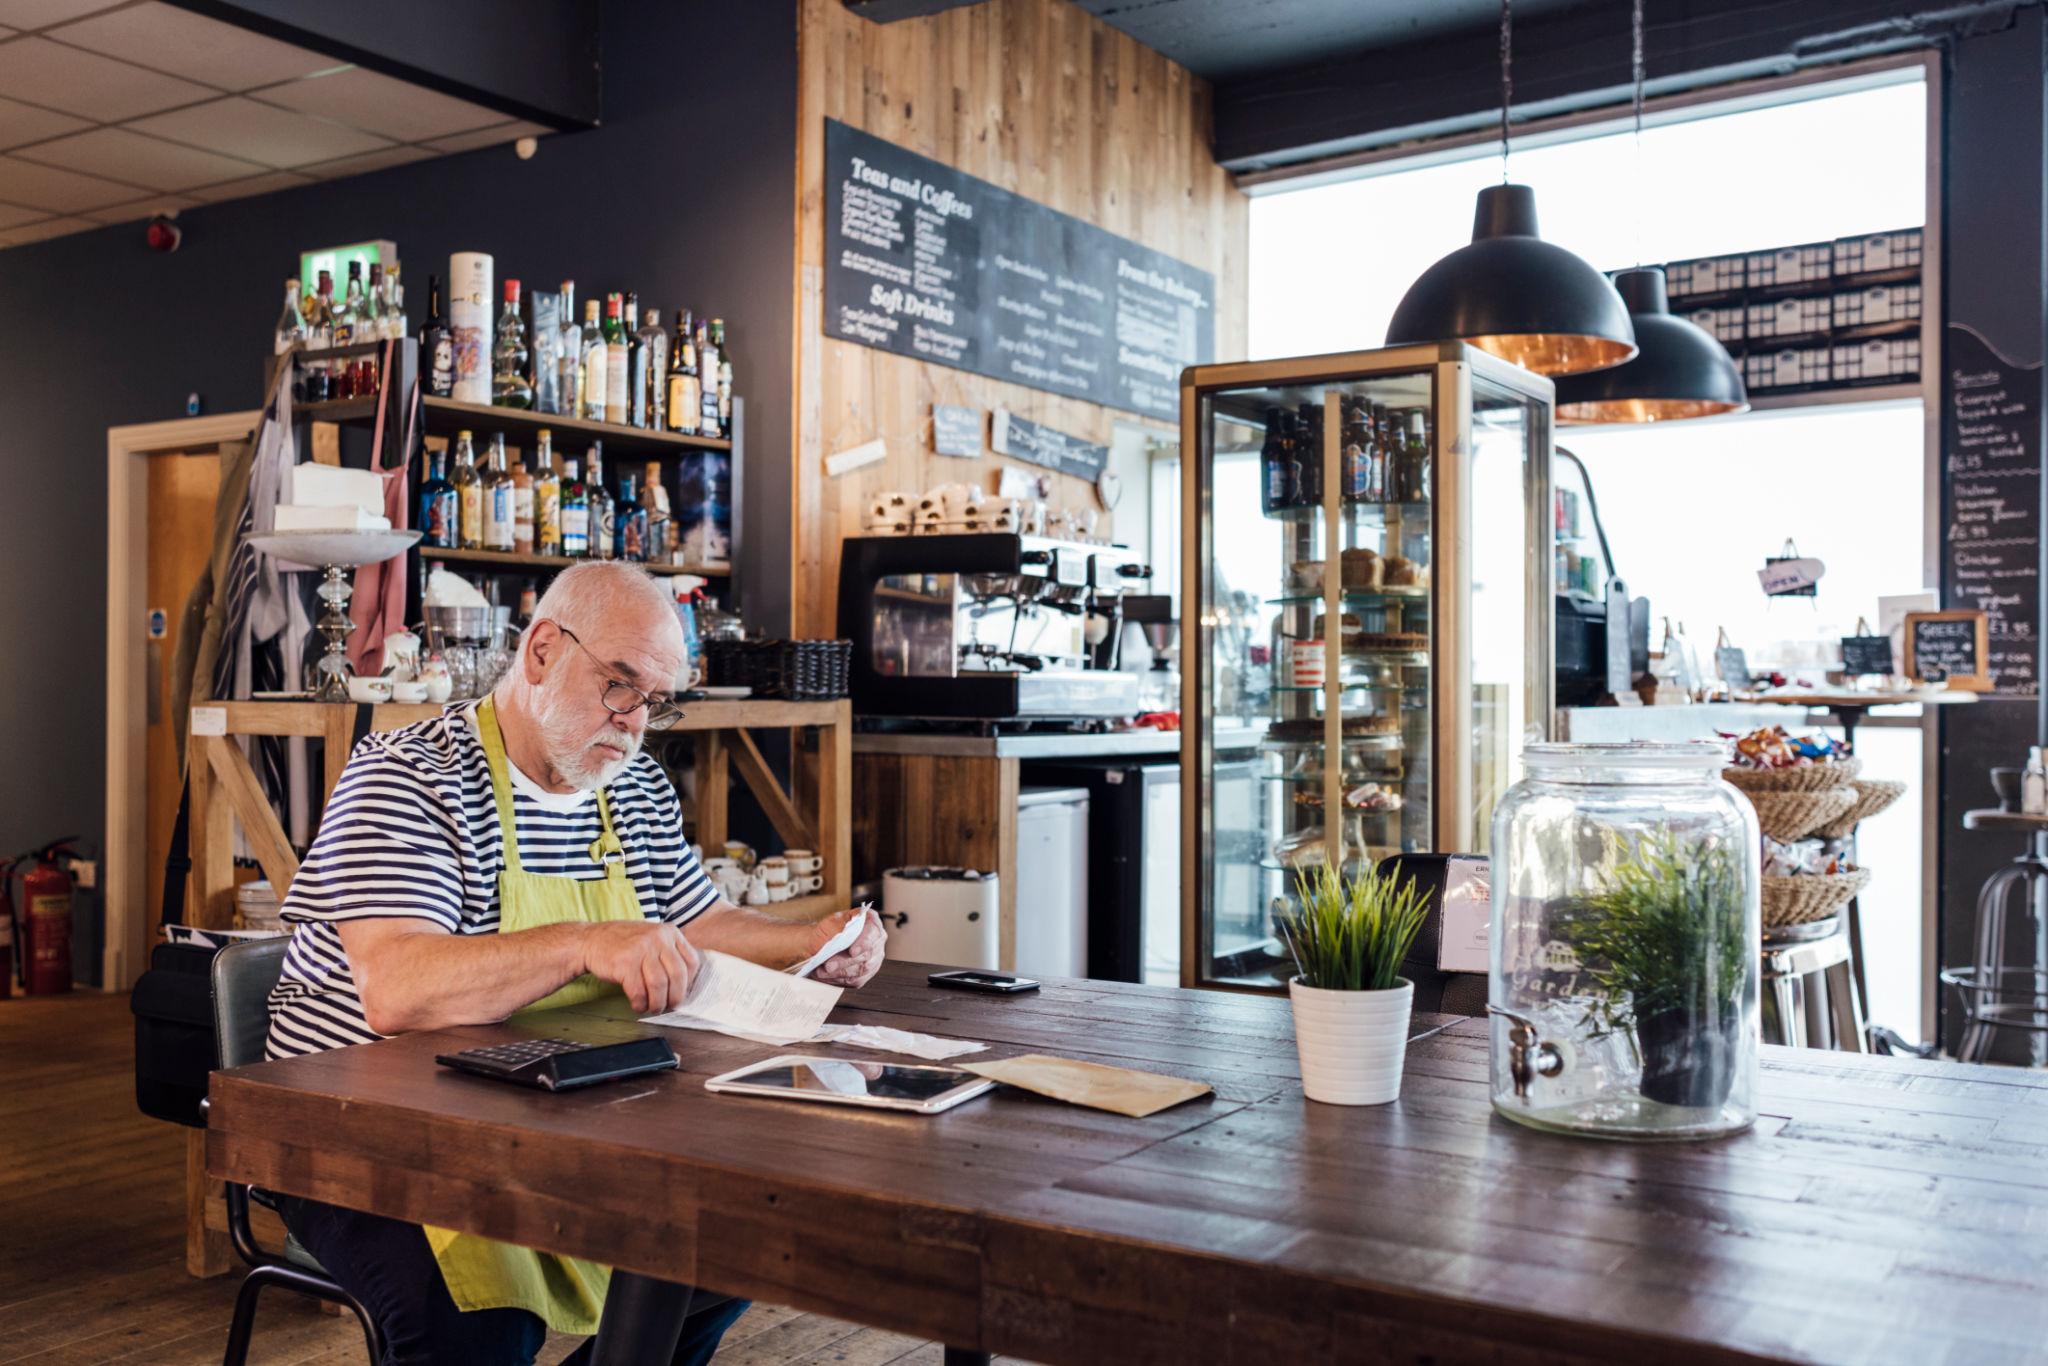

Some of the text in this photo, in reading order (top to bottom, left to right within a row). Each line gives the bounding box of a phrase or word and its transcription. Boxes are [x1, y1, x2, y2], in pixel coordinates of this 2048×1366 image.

[851, 157, 890, 190] Teas
[890, 177, 921, 200] and
[921, 184, 973, 220] Coffees
[869, 283, 903, 314] Soft
[904, 294, 955, 326] Drinks
